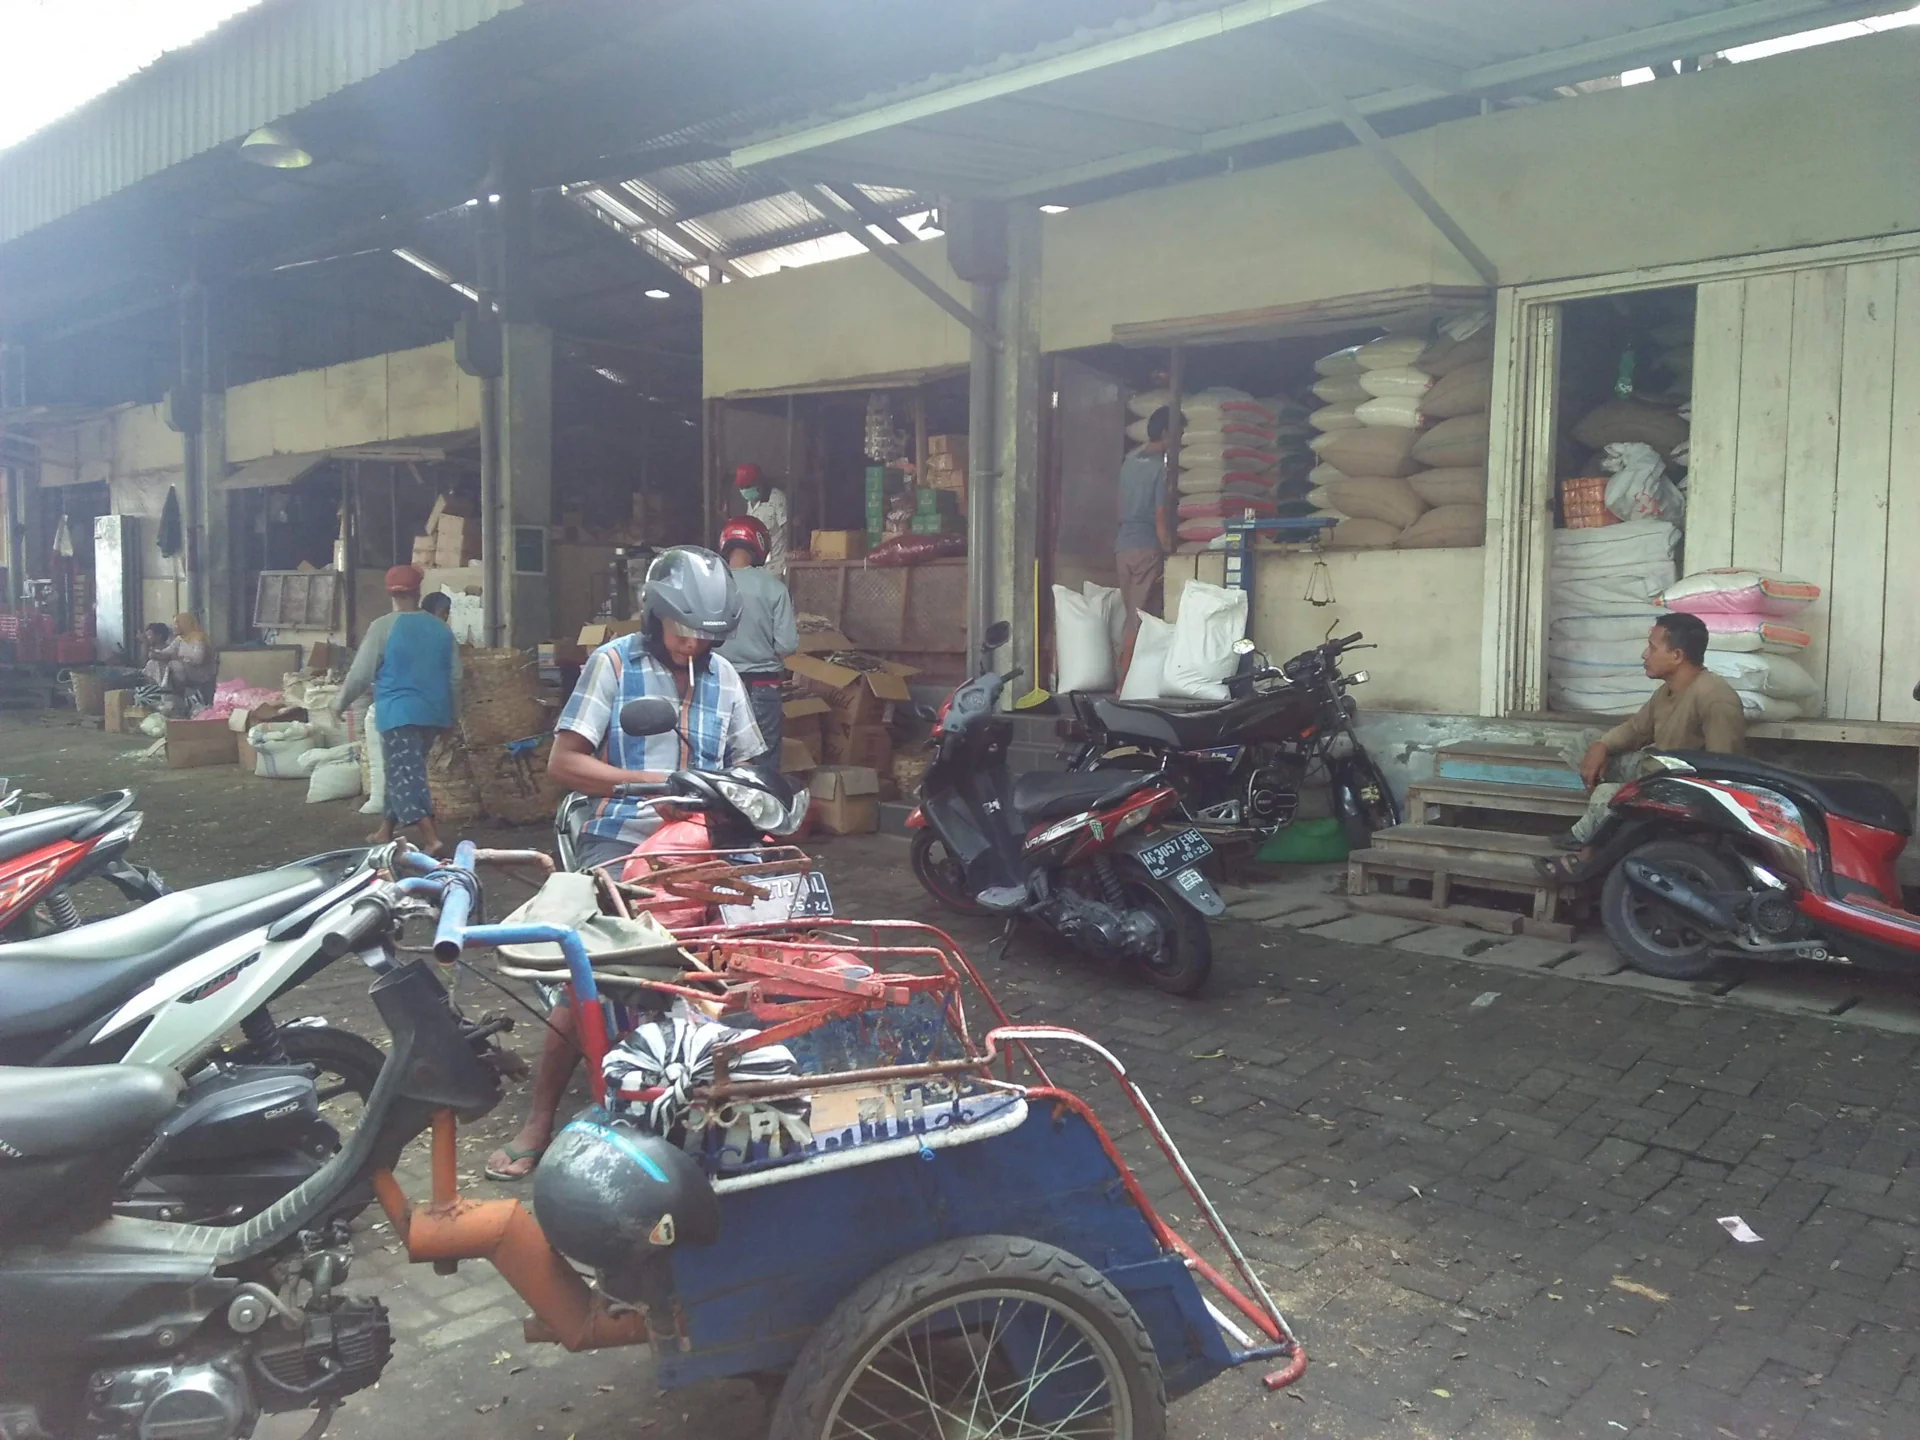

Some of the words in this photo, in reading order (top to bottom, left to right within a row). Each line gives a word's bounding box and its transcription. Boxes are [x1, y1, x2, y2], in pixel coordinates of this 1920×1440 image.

[1142, 851, 1157, 866] AG
[1153, 839, 1180, 859] 3057
[1178, 830, 1201, 848] EBE
